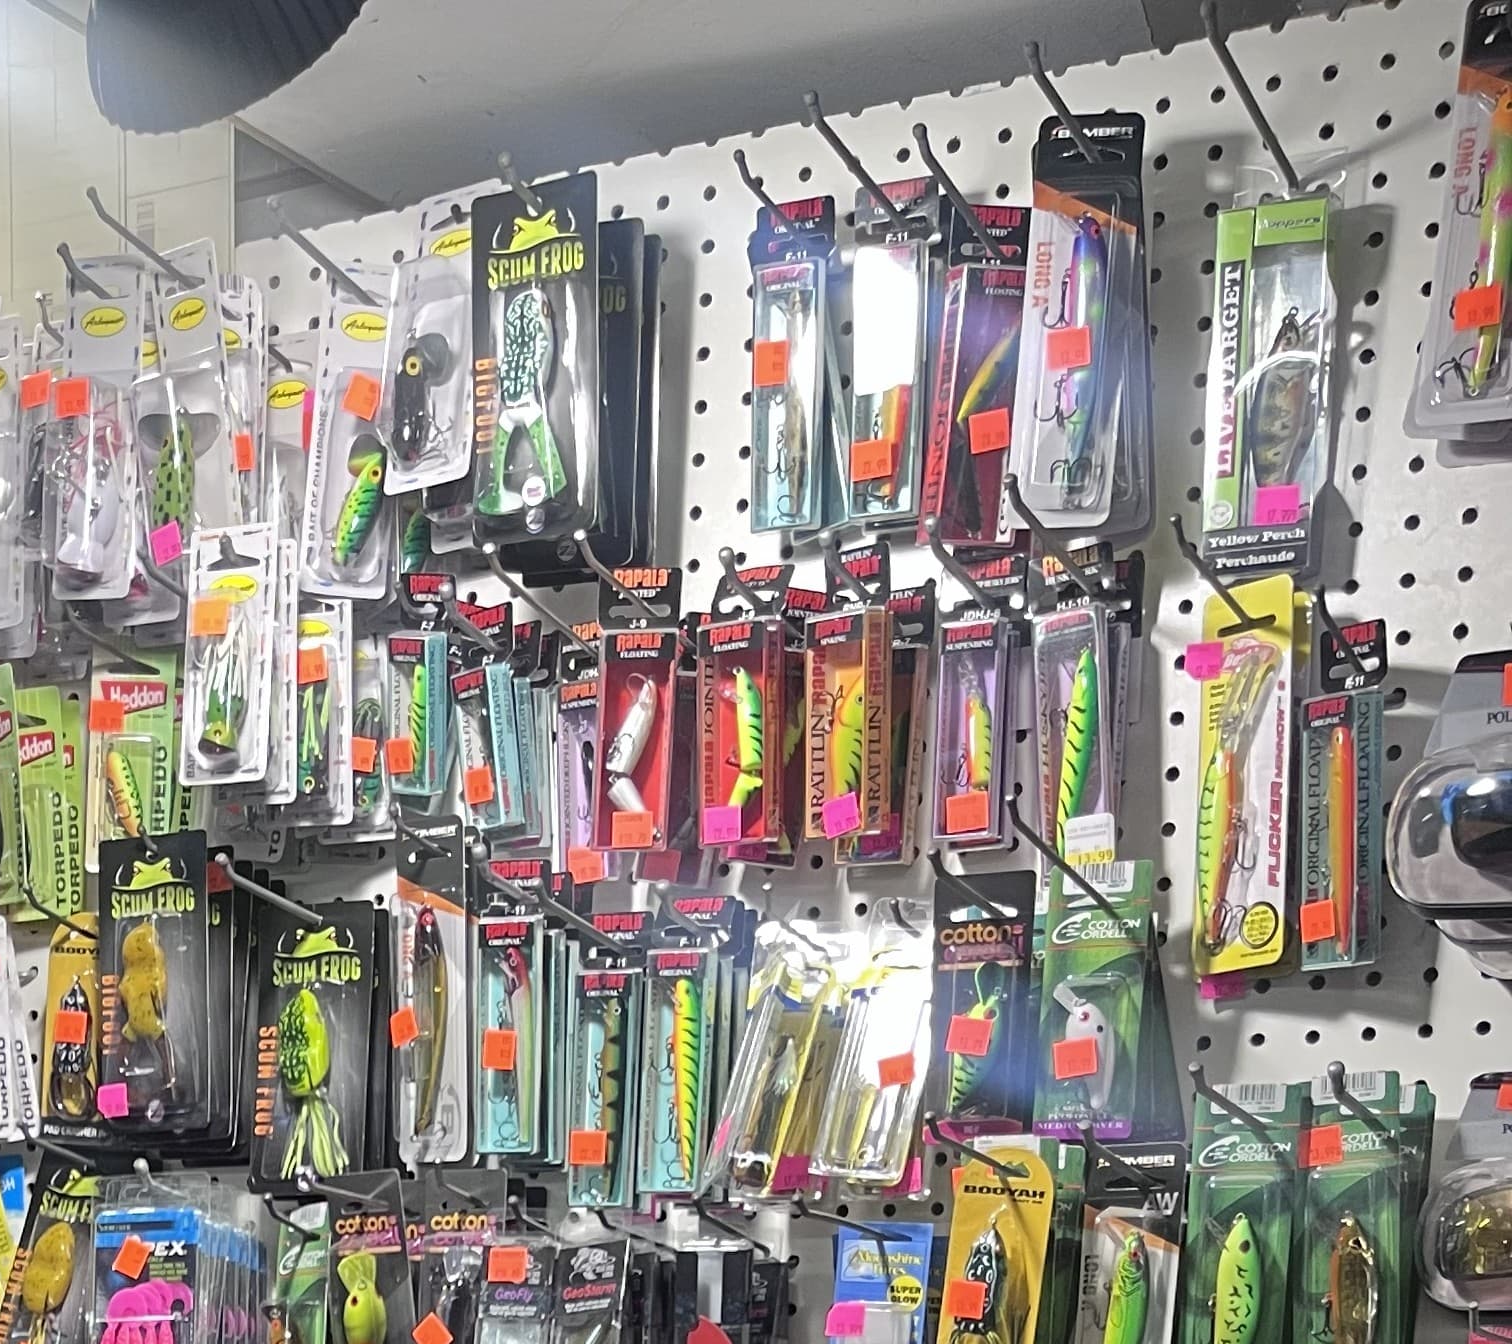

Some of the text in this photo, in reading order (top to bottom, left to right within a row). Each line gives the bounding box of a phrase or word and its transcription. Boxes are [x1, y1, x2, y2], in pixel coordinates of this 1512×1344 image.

[487, 241, 585, 290] SCUM FROG
[1207, 527, 1306, 548] Yellow Perch
[629, 618, 647, 629] J-9
[103, 680, 166, 714] Heddon
[811, 711, 826, 809] RATTLIN
[54, 791, 66, 909] TORPEDO
[70, 804, 81, 915] TORPEDO
[111, 884, 195, 918] SCUM FROG
[1087, 917, 1141, 930] COTTON
[939, 925, 1010, 946] cotton
[272, 954, 362, 984] SCUM FROG
[259, 1025, 278, 1075] SCUM
[1236, 1141, 1292, 1154] COTTON
[963, 1184, 1045, 1201] BOOYAH
[1142, 1193, 1179, 1215] AW
[495, 1287, 533, 1301] GeoFly
[890, 1285, 921, 1295] SUPER
